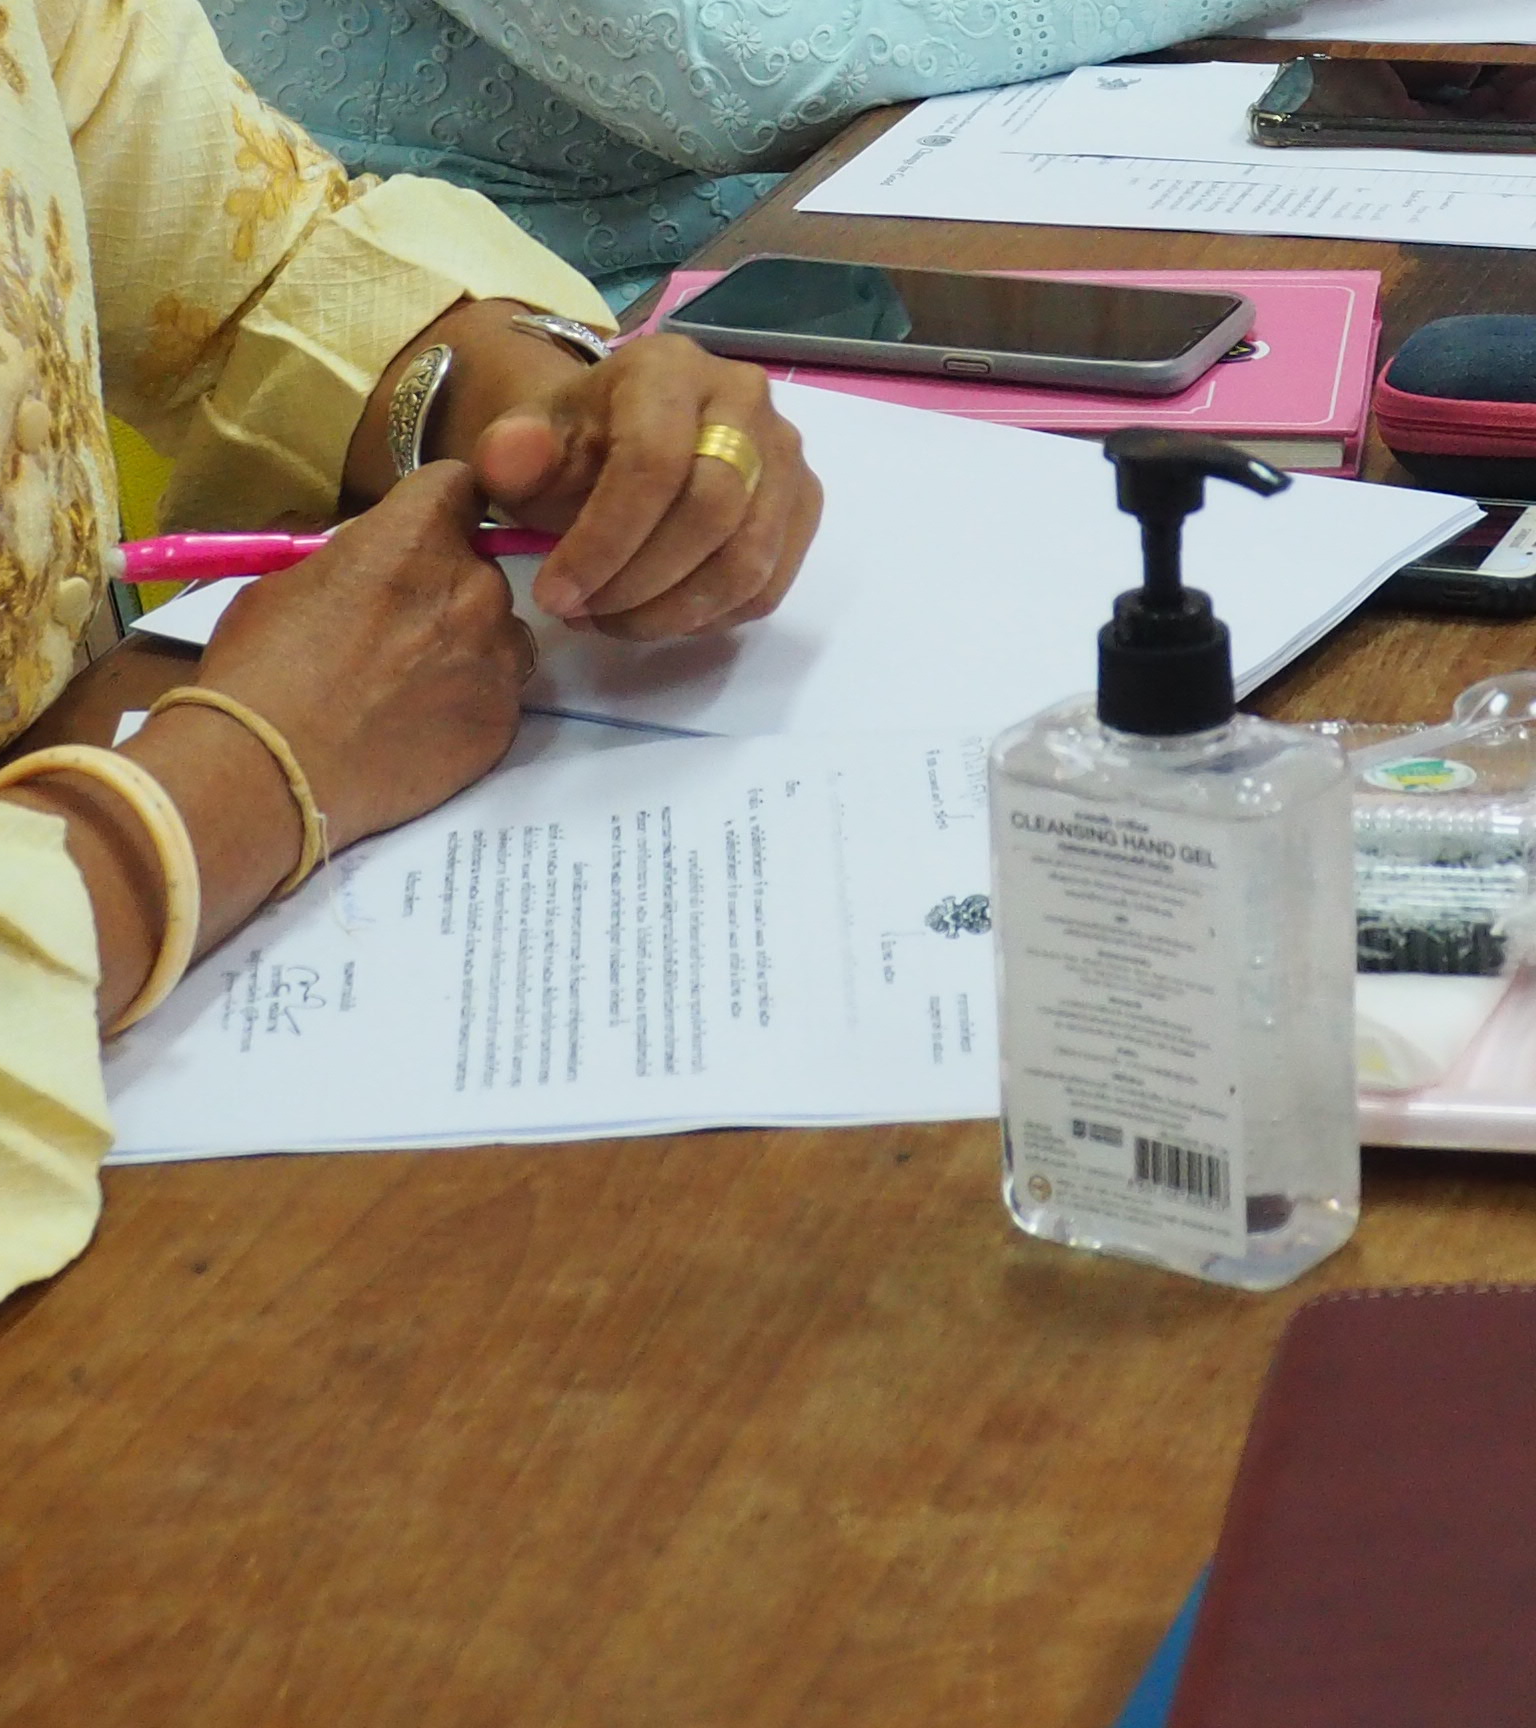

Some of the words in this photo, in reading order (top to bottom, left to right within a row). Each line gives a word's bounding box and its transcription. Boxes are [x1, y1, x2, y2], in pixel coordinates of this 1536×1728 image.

[1011, 809, 1118, 848] CLEANSING
[1123, 831, 1176, 860] HAND
[1180, 843, 1218, 870] GEL
